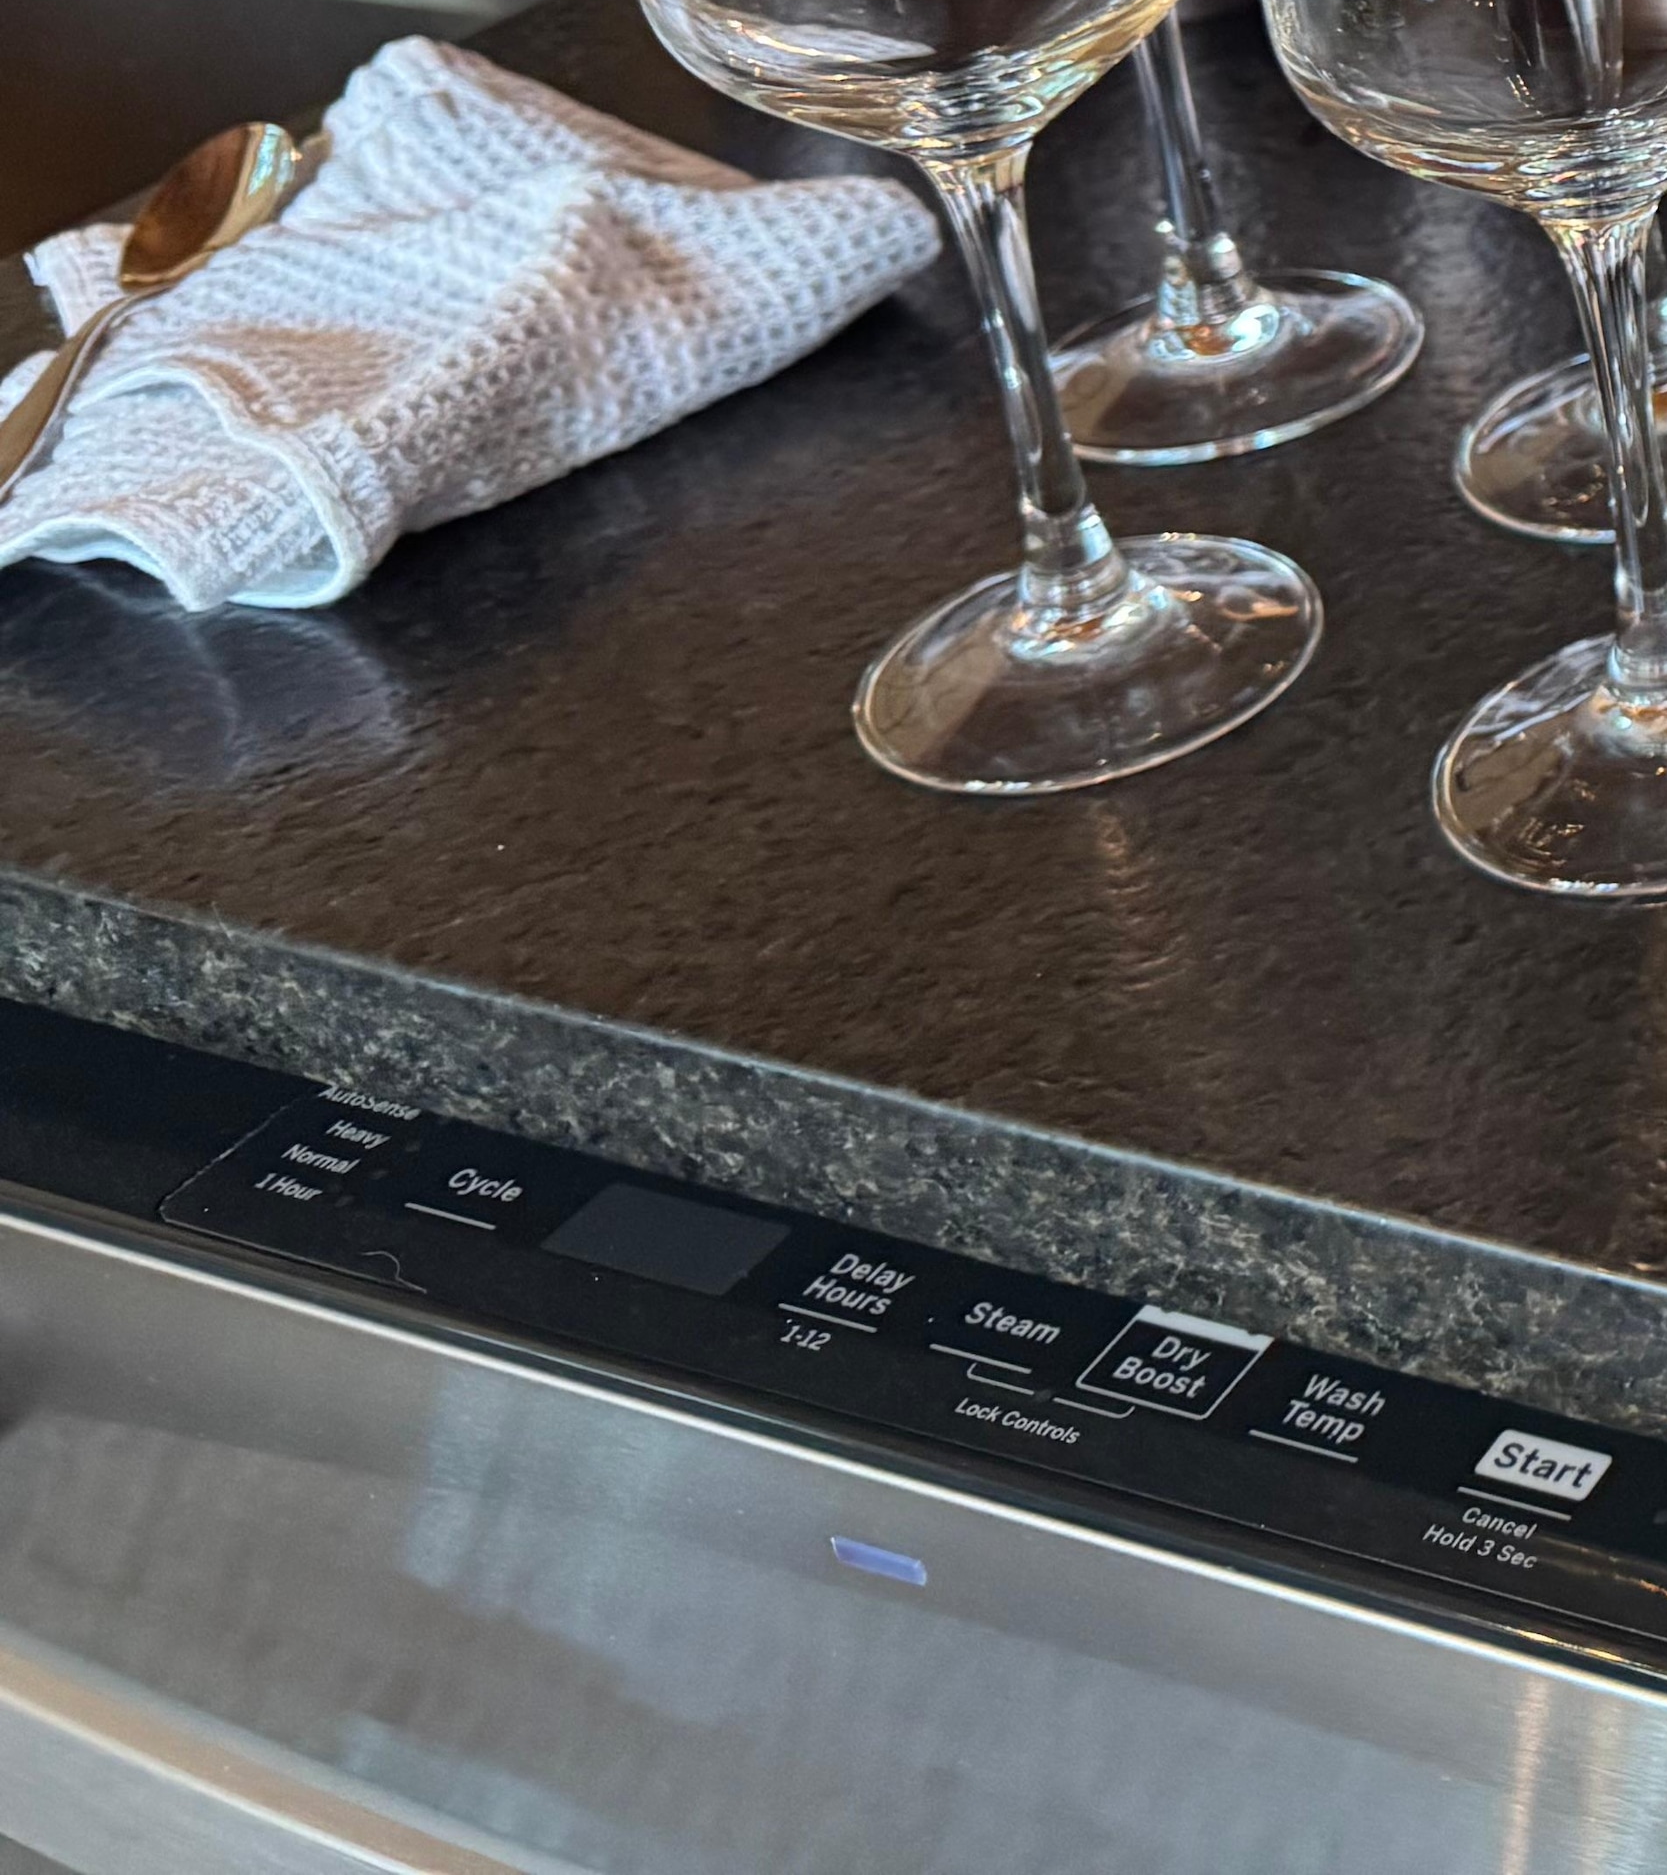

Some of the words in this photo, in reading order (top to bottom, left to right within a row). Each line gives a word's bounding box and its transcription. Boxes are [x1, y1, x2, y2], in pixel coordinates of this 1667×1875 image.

[317, 1080, 422, 1121] AutoSense
[326, 1119, 392, 1150] Heavy
[281, 1142, 362, 1175] Normal
[269, 1175, 324, 1202] Hour
[447, 1168, 524, 1203] Cycle
[830, 1252, 917, 1295] Delay
[802, 1275, 893, 1318] Hours
[779, 1323, 833, 1353] 1-12
[963, 1300, 1063, 1347] Steam
[1151, 1334, 1213, 1370] Dry
[1112, 1356, 1208, 1401] Boost
[1302, 1373, 1387, 1417] Wash
[955, 1397, 1000, 1424] Lock
[1001, 1409, 1082, 1446] Controls
[1281, 1399, 1366, 1445] Temp
[1492, 1441, 1595, 1491] Start
[1460, 1505, 1538, 1540] Cancel
[1422, 1523, 1477, 1558] Hold
[1475, 1539, 1494, 1557] 3
[1495, 1544, 1539, 1571] Sec
